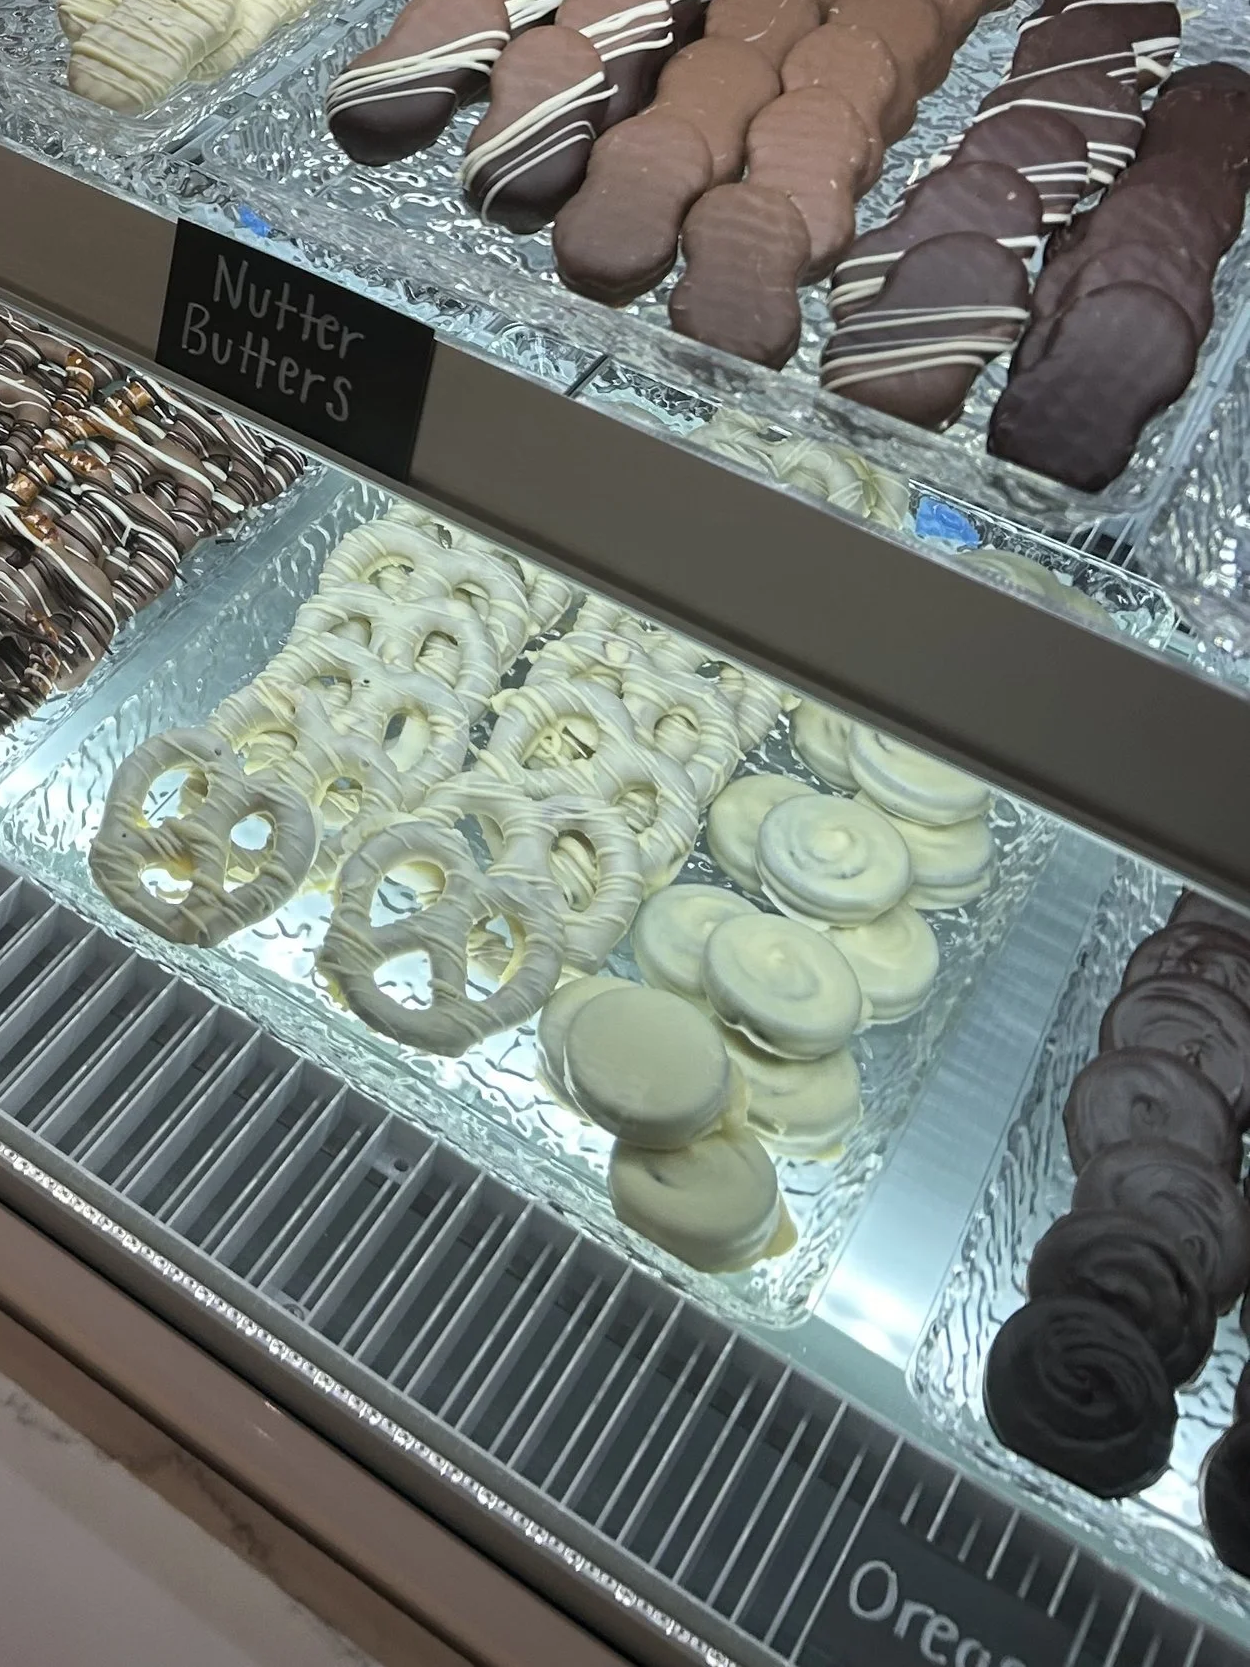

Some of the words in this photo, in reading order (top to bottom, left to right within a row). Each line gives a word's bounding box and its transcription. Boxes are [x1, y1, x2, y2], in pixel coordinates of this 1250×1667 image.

[213, 254, 367, 360] Nutter
[181, 302, 352, 422] Butters
[849, 1559, 1027, 1667] Oreo
